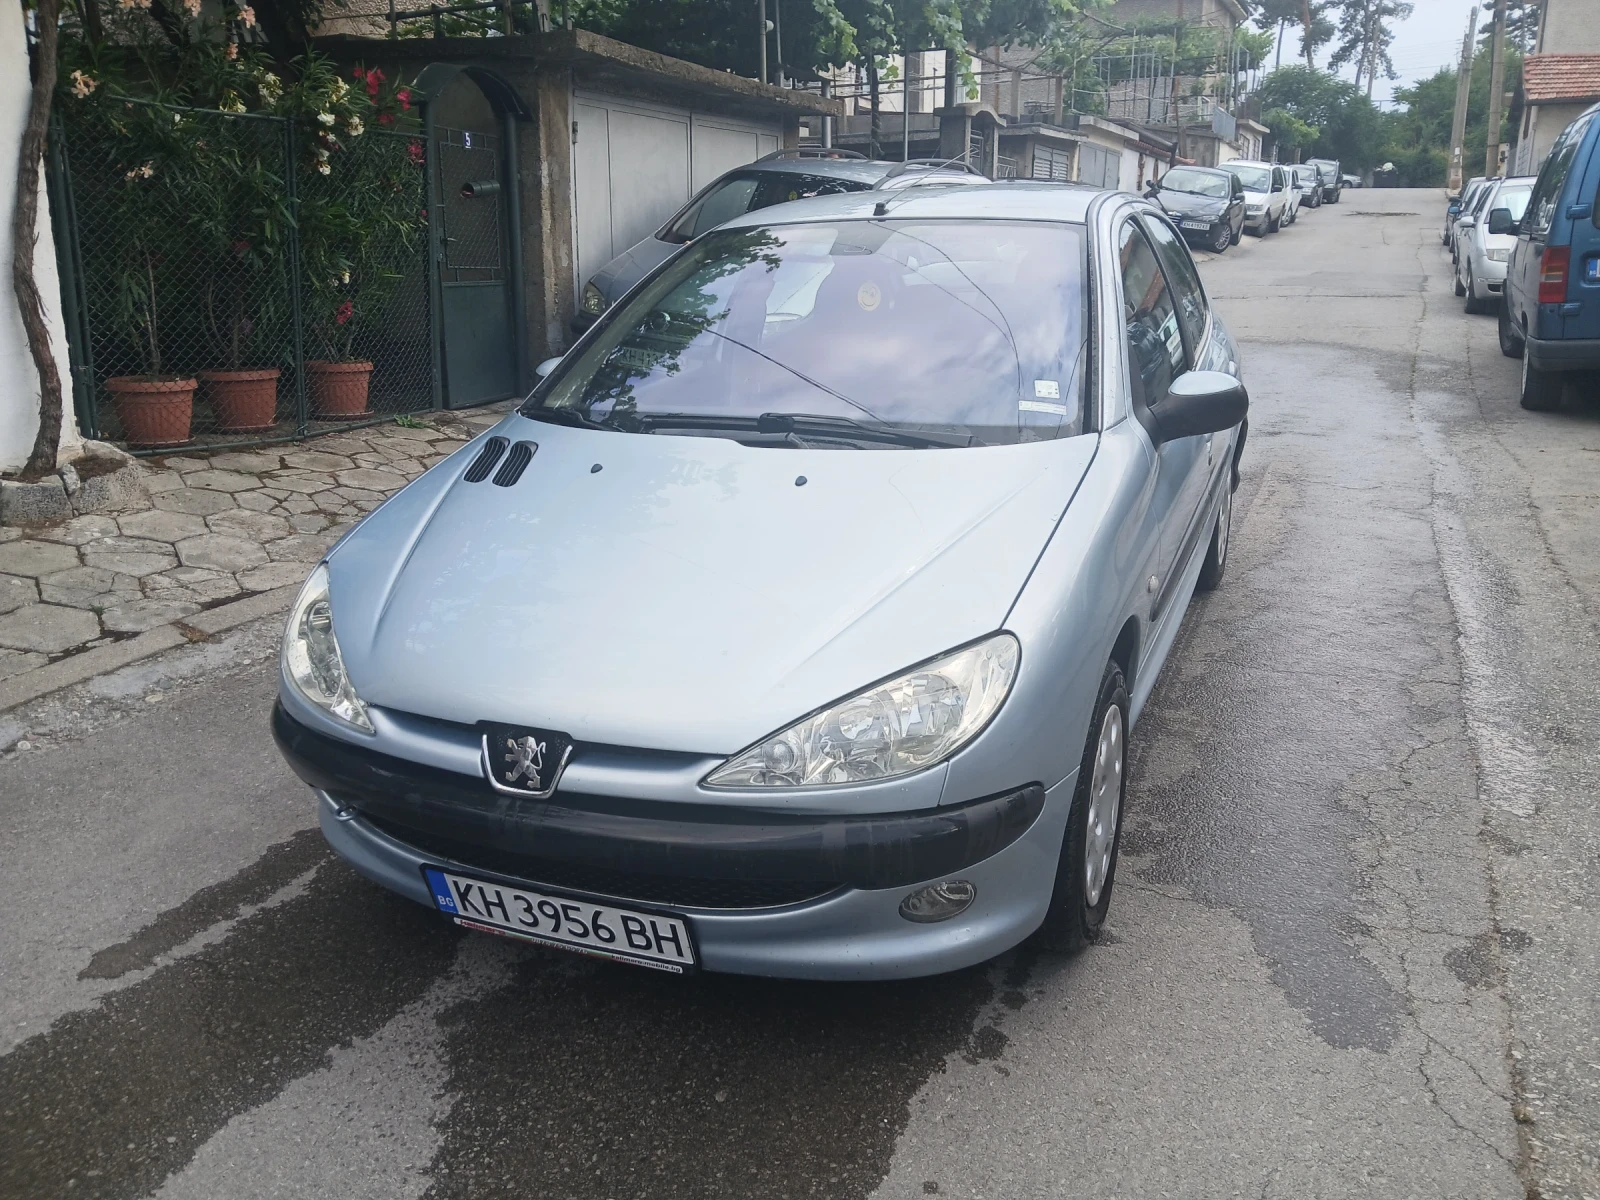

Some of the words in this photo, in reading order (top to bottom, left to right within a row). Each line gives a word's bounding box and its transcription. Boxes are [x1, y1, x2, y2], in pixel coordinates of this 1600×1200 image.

[465, 132, 471, 146] 5
[437, 895, 454, 906] BG
[513, 893, 616, 943] 3956
[620, 914, 684, 957] BH
